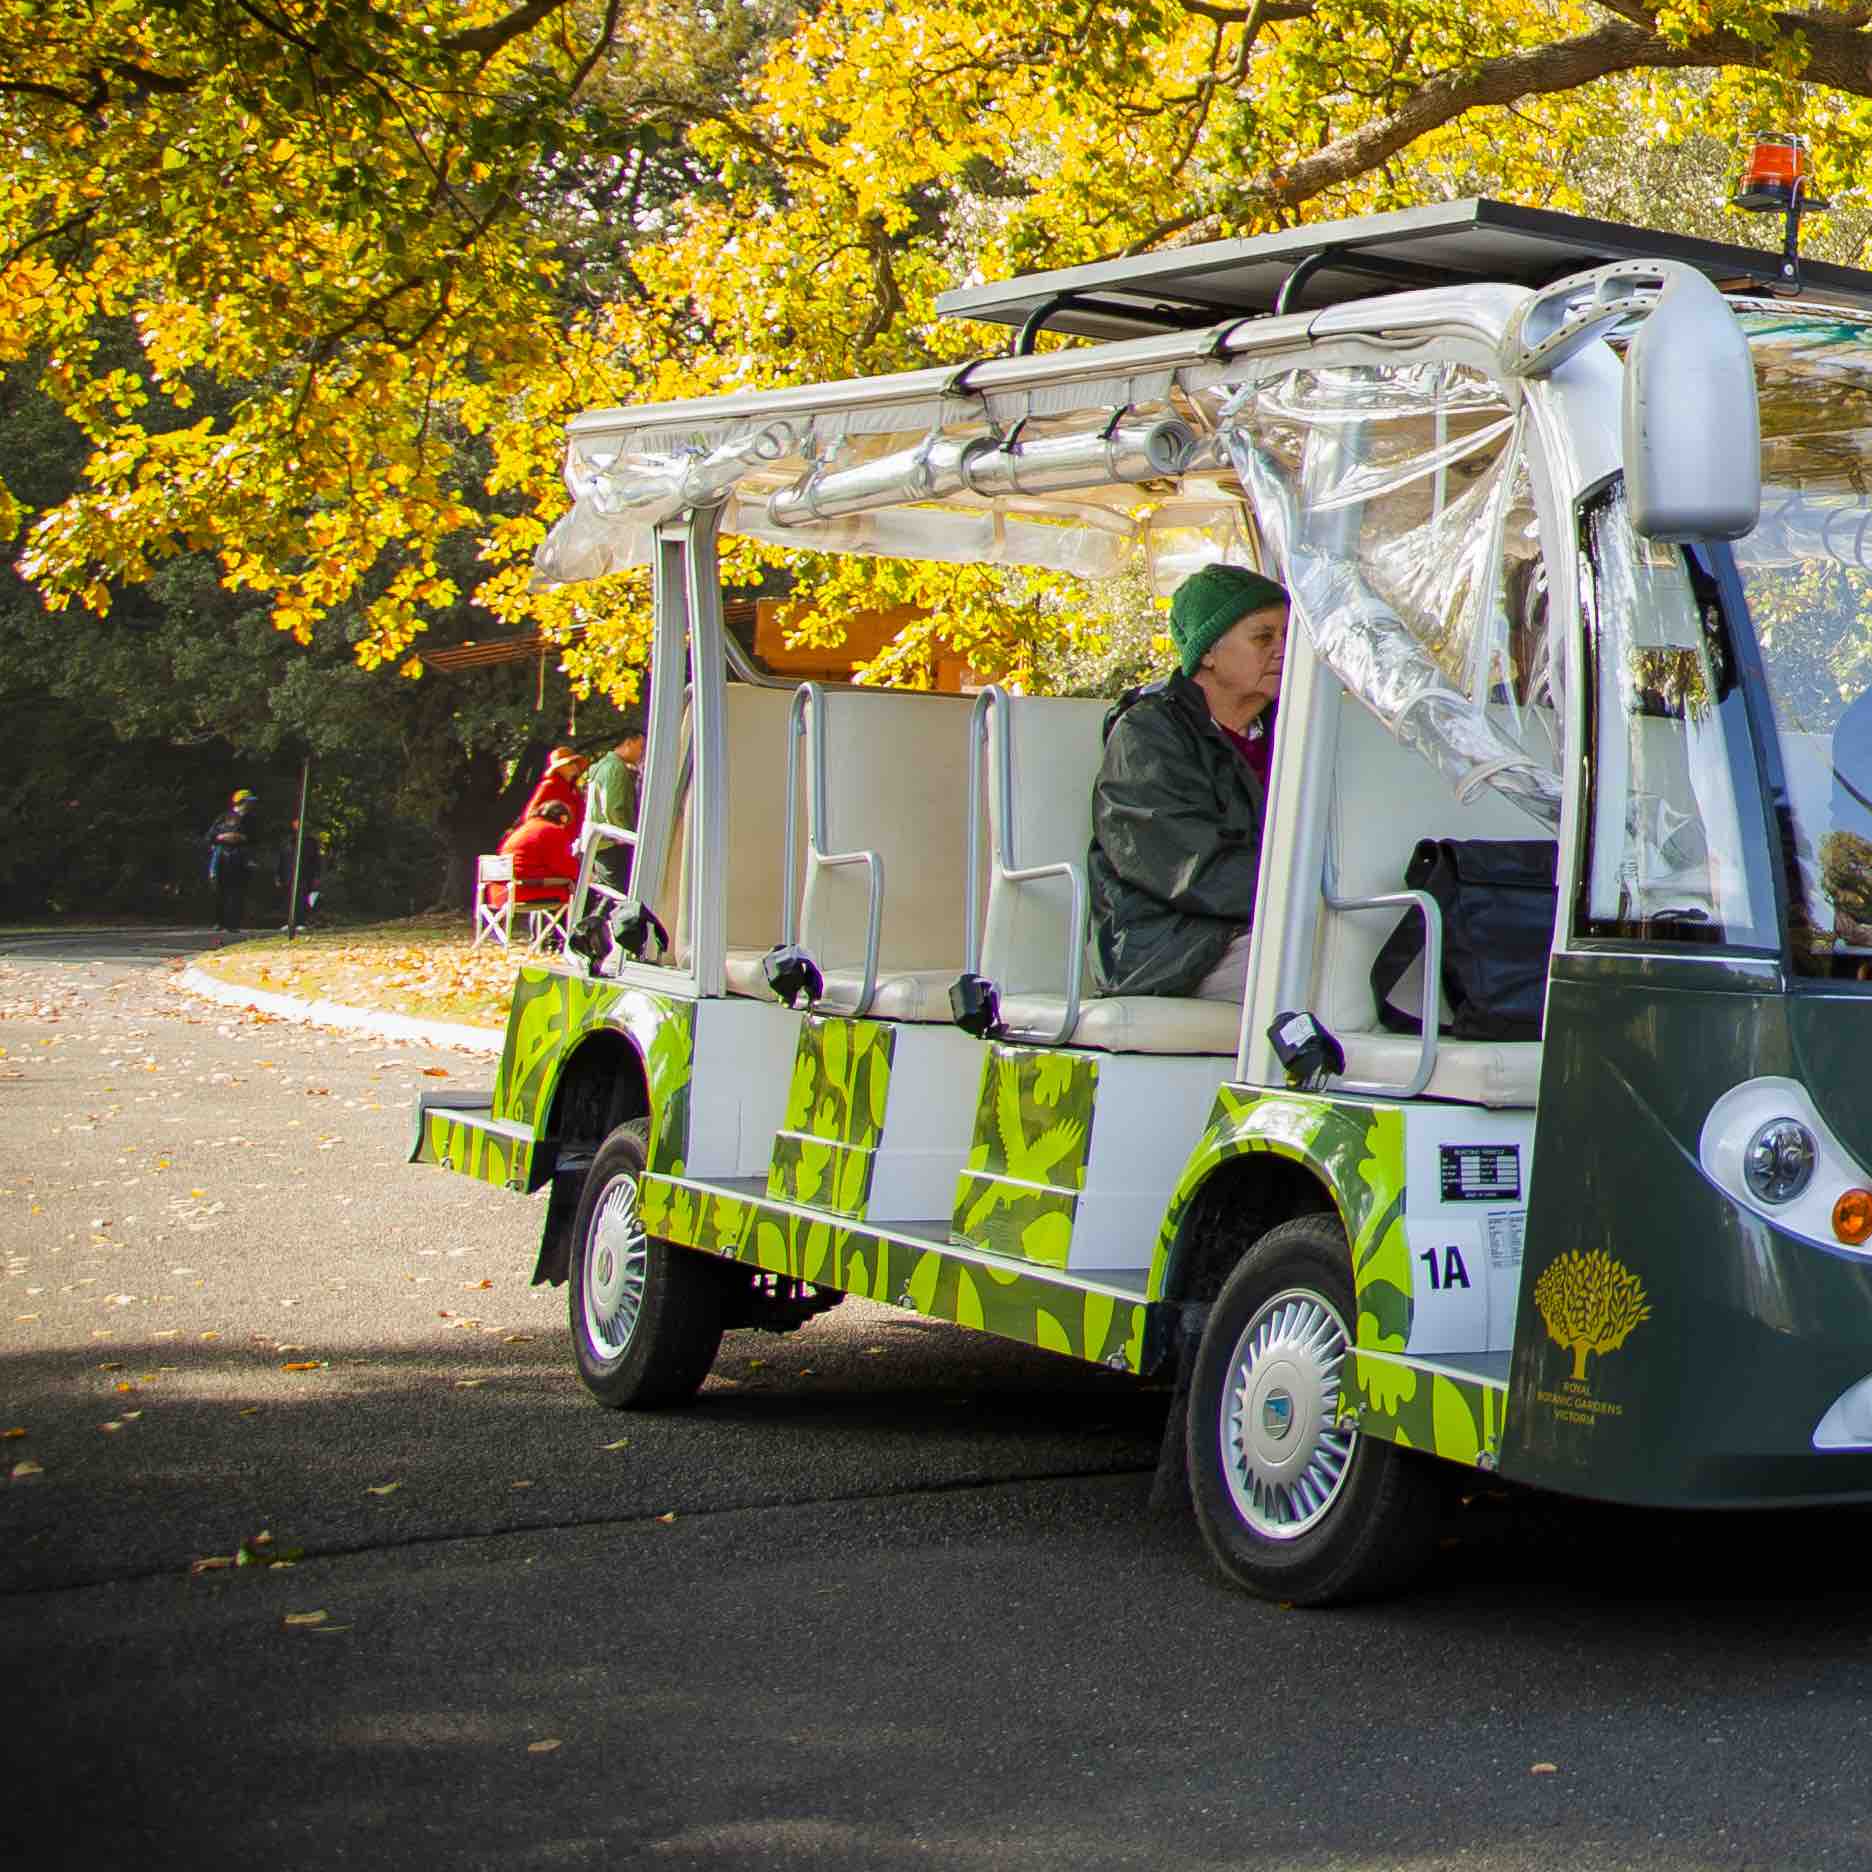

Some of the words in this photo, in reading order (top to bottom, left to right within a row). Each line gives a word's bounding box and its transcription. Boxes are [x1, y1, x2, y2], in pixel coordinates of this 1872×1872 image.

[1420, 1246, 1471, 1289] 1A
[1563, 1380, 1592, 1394] ROYAL
[1574, 1398, 1623, 1416] GARDENS
[1553, 1410, 1595, 1424] VICTORIA
